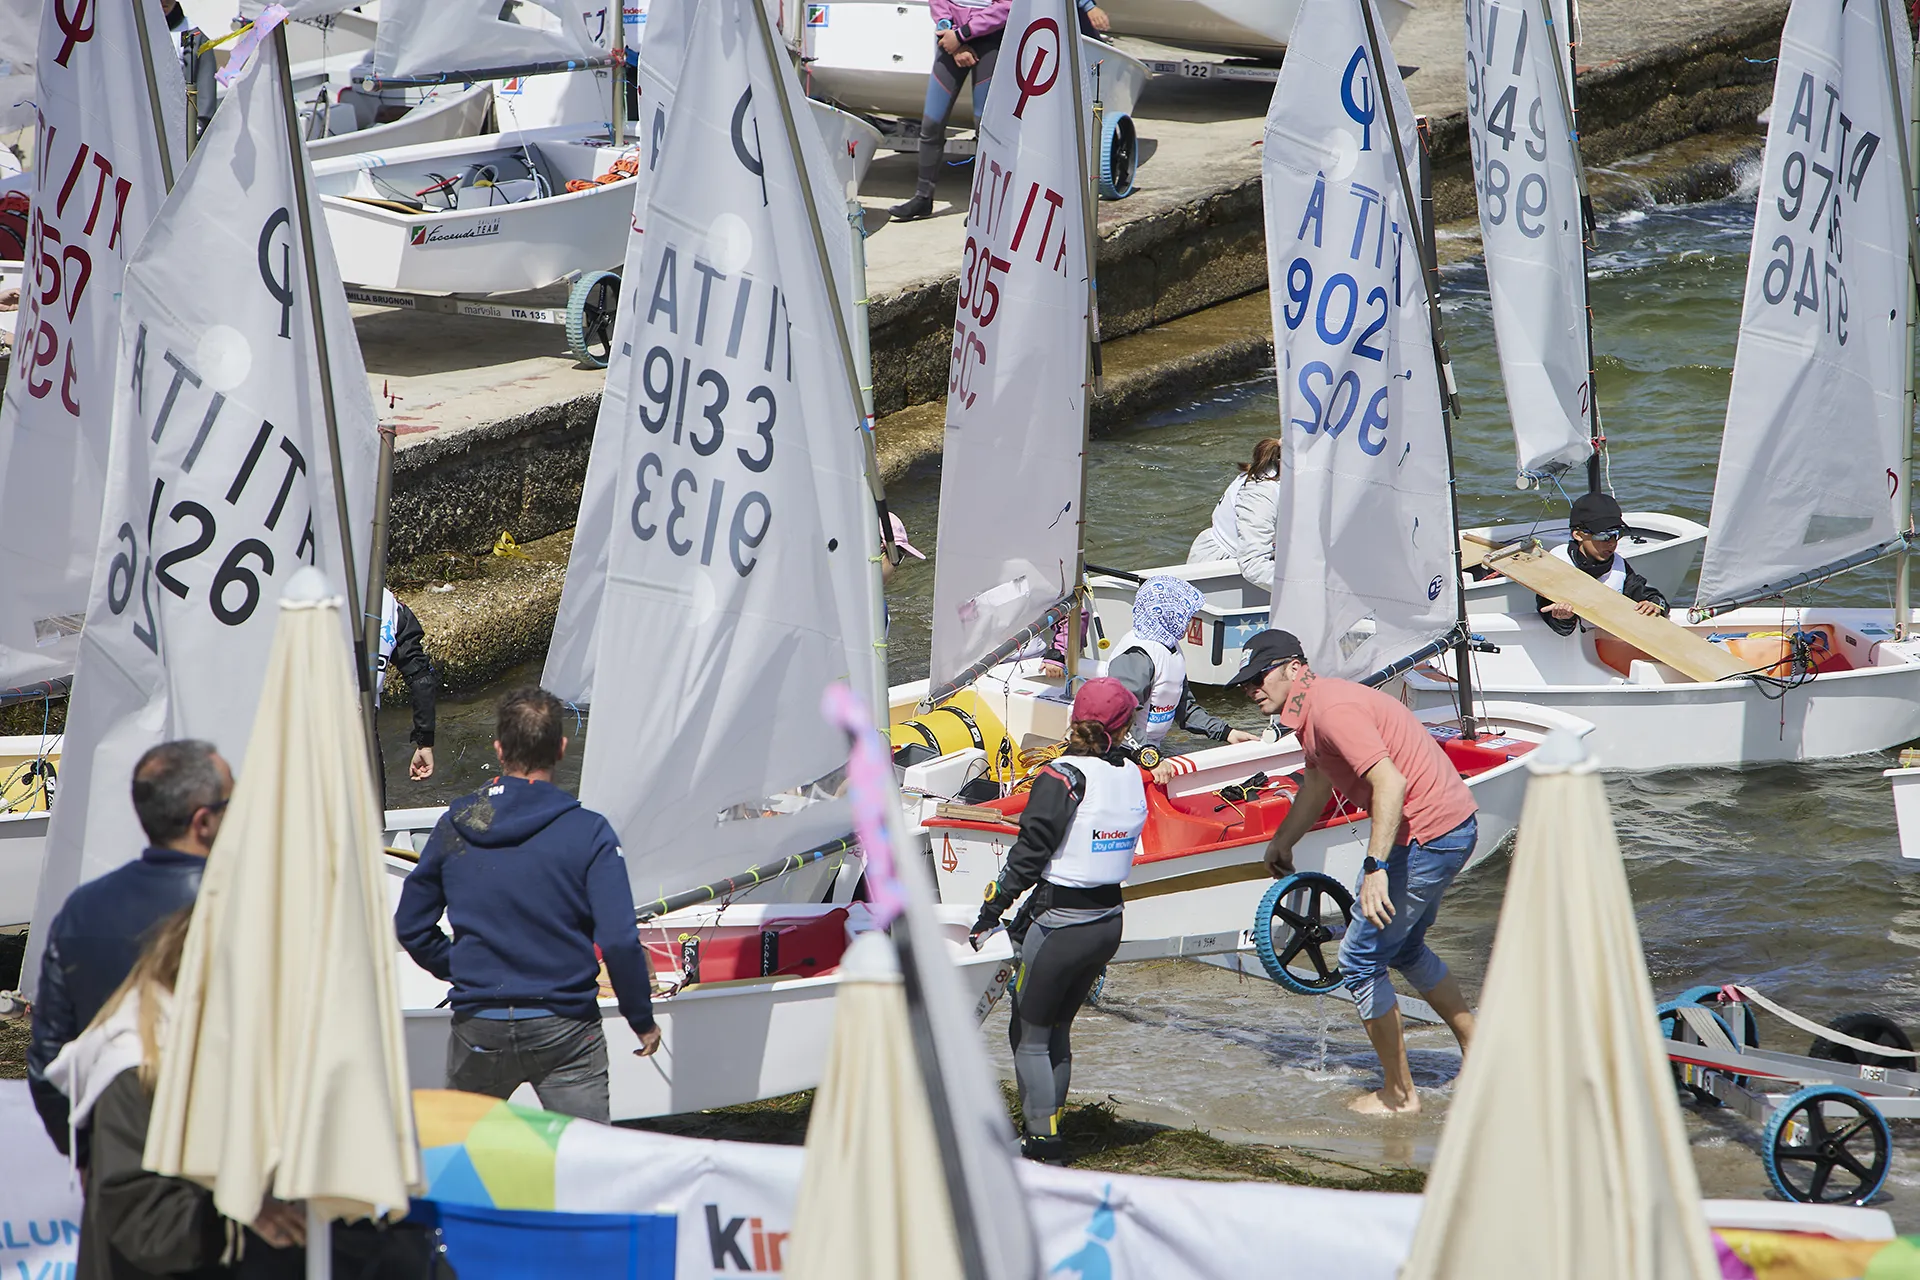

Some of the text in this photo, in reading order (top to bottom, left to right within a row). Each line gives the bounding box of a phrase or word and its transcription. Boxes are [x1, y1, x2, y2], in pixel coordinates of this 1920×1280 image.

[1184, 64, 1208, 77] 122
[56, 142, 133, 260] ITA
[476, 223, 500, 235] TEAM
[345, 292, 414, 306] MILLA BRUGNONI
[511, 309, 527, 319] ITA
[529, 311, 547, 321] 135
[638, 345, 778, 474] 9133
[147, 476, 275, 627] 126
[1092, 829, 1128, 841] Kinder
[1093, 842, 1108, 851] Joy
